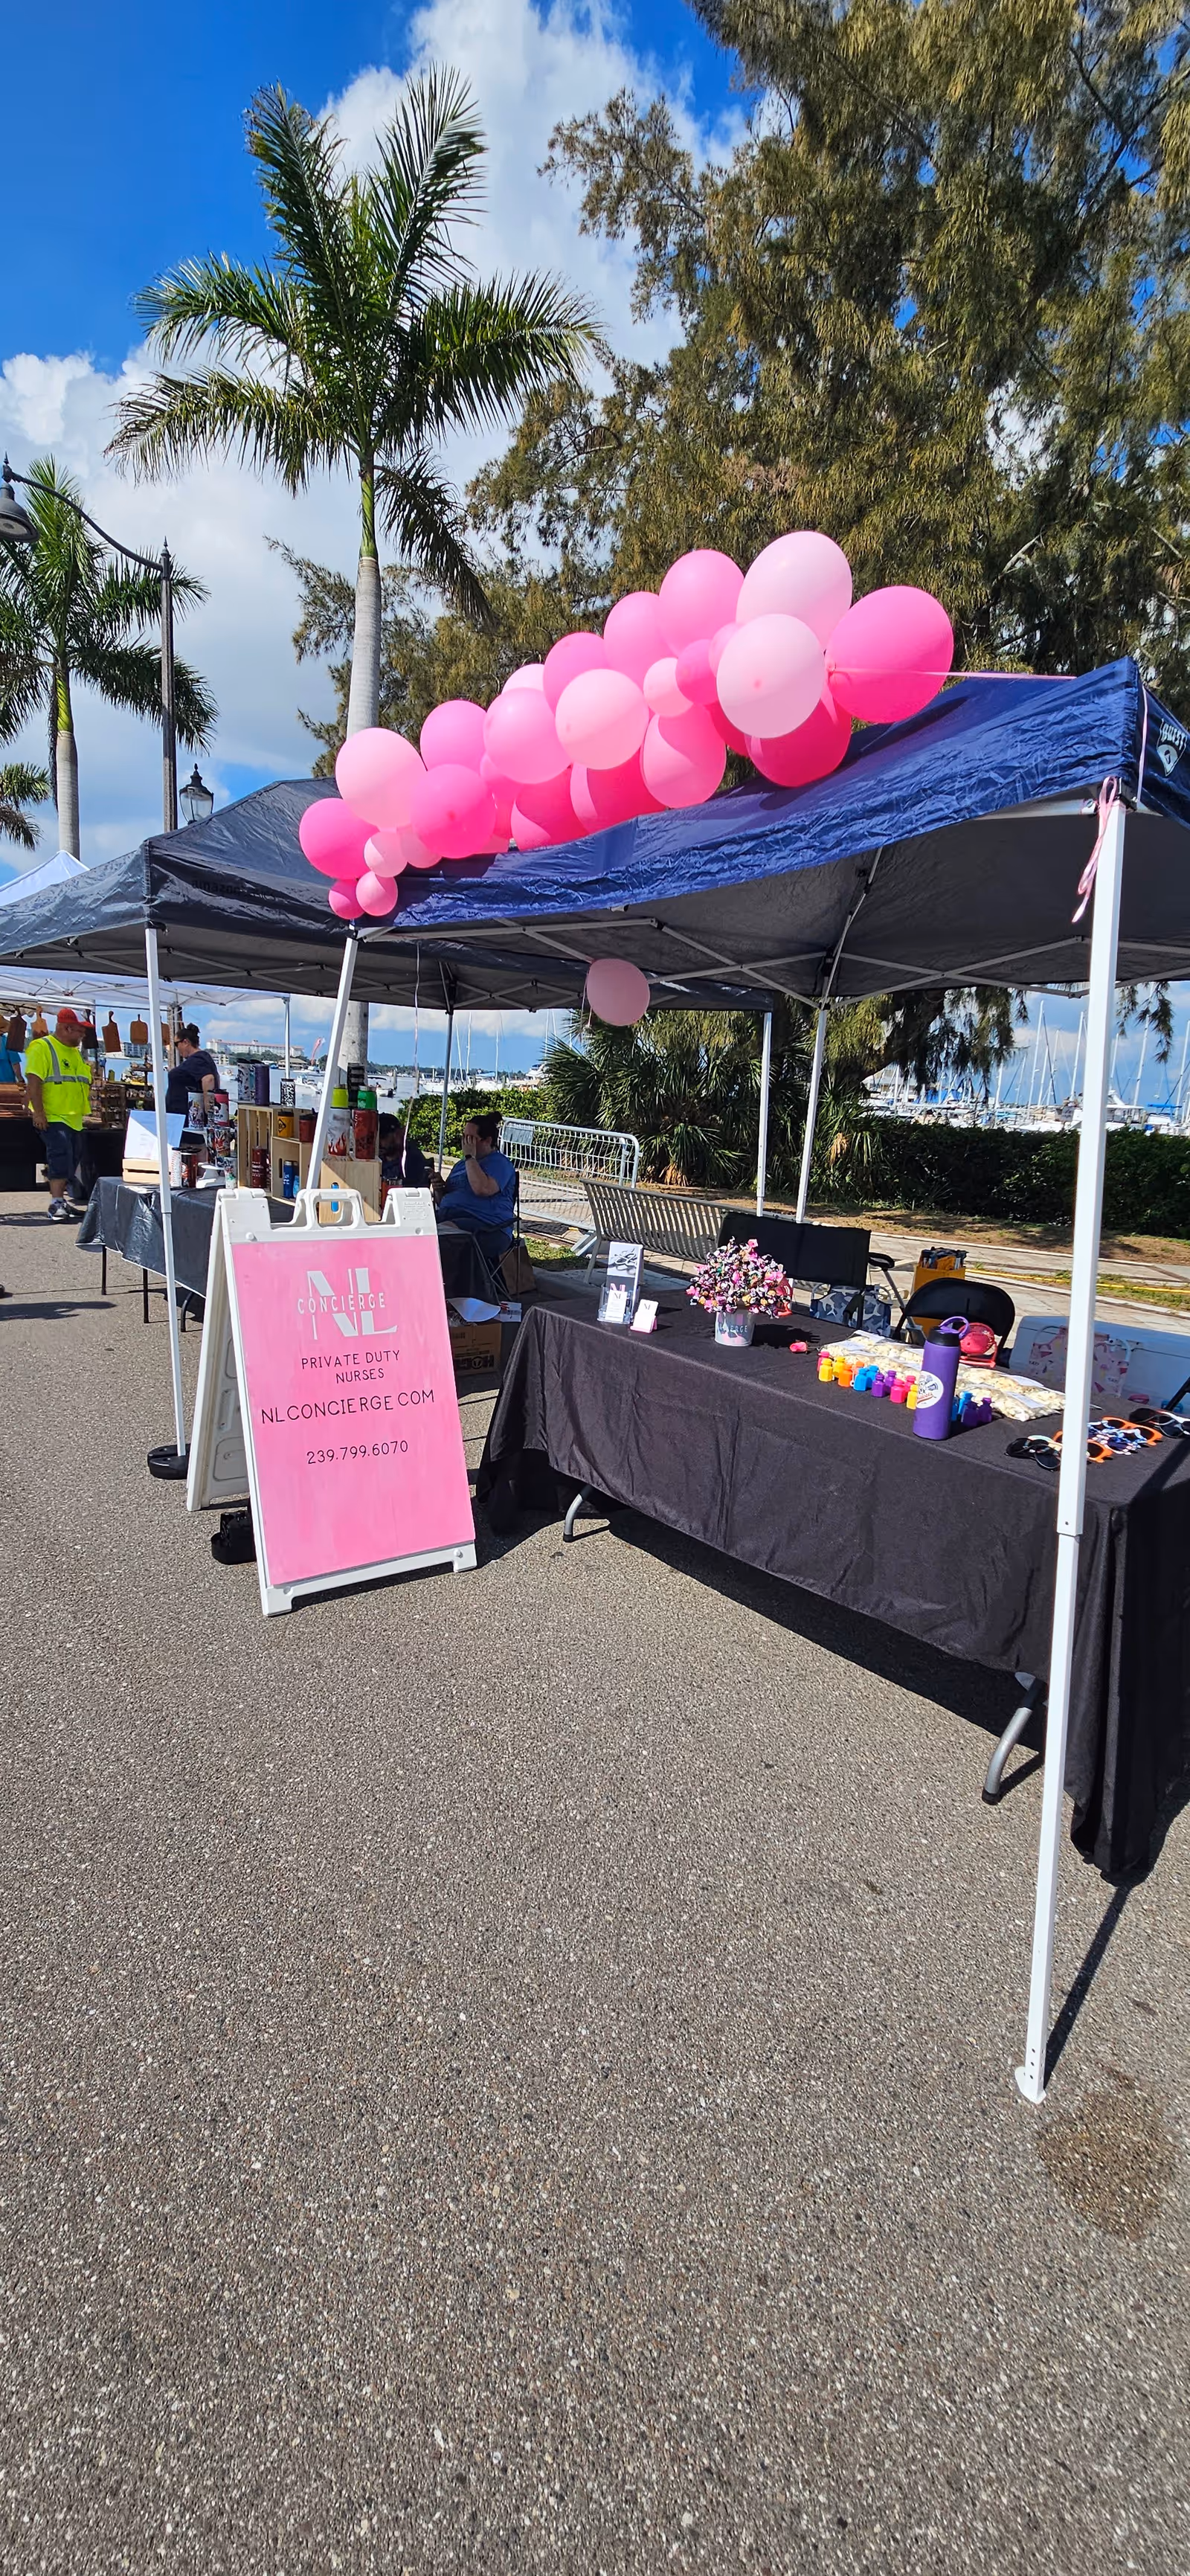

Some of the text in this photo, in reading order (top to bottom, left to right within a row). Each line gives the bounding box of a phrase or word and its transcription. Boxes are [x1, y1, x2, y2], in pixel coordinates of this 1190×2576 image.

[298, 1292, 385, 1315] CONCIERGE
[301, 1349, 400, 1369] PRIVATE DUTY
[335, 1368, 385, 1384] NURSES
[306, 1439, 408, 1465] 239.799.6070
